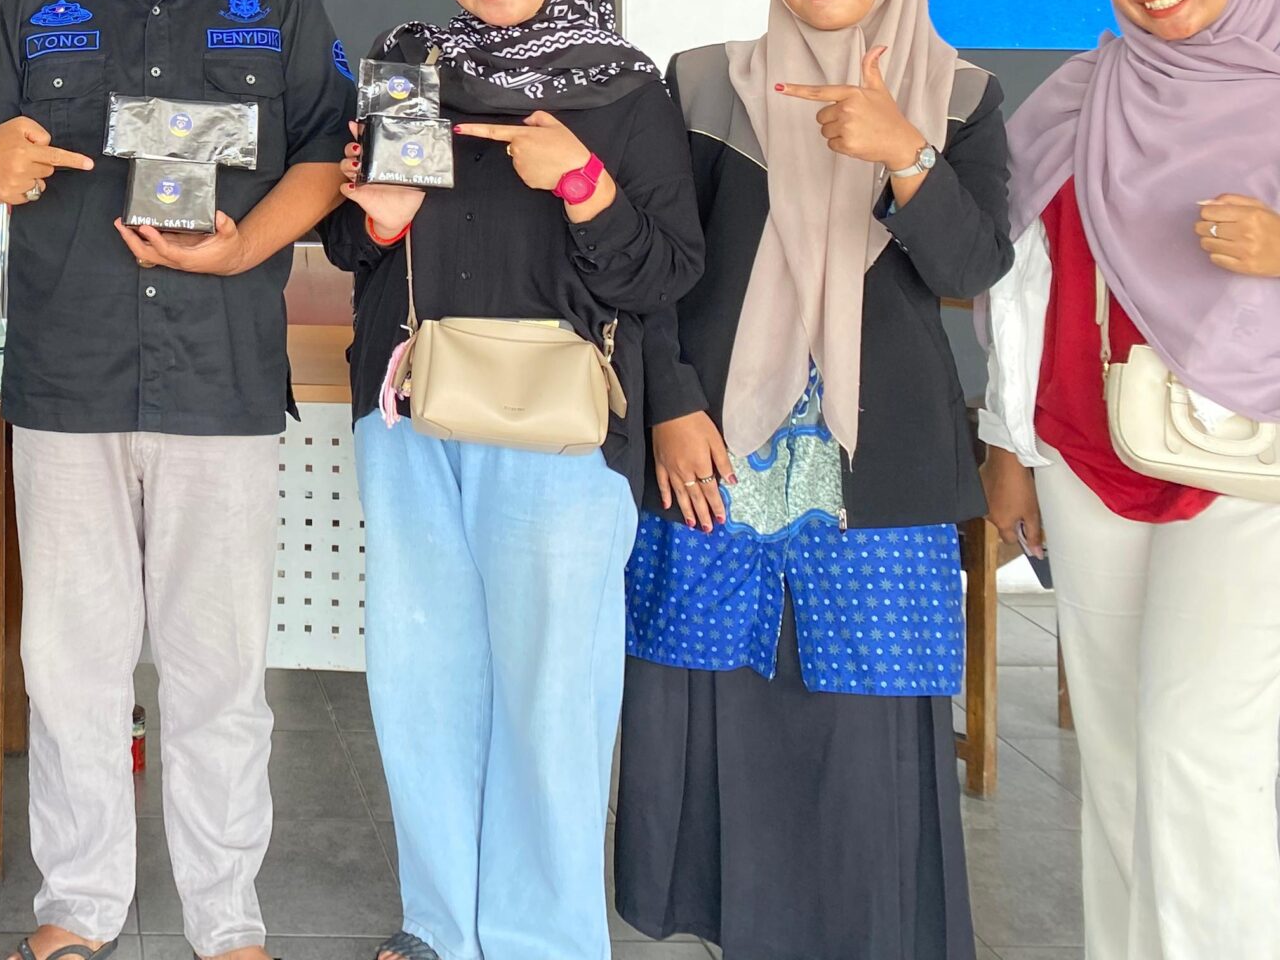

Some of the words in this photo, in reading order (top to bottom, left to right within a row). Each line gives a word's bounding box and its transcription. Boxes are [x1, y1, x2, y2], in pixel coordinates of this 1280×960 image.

[33, 34, 88, 51] YONO
[212, 31, 280, 48] PENYIDIK
[163, 218, 196, 230] GRATIS
